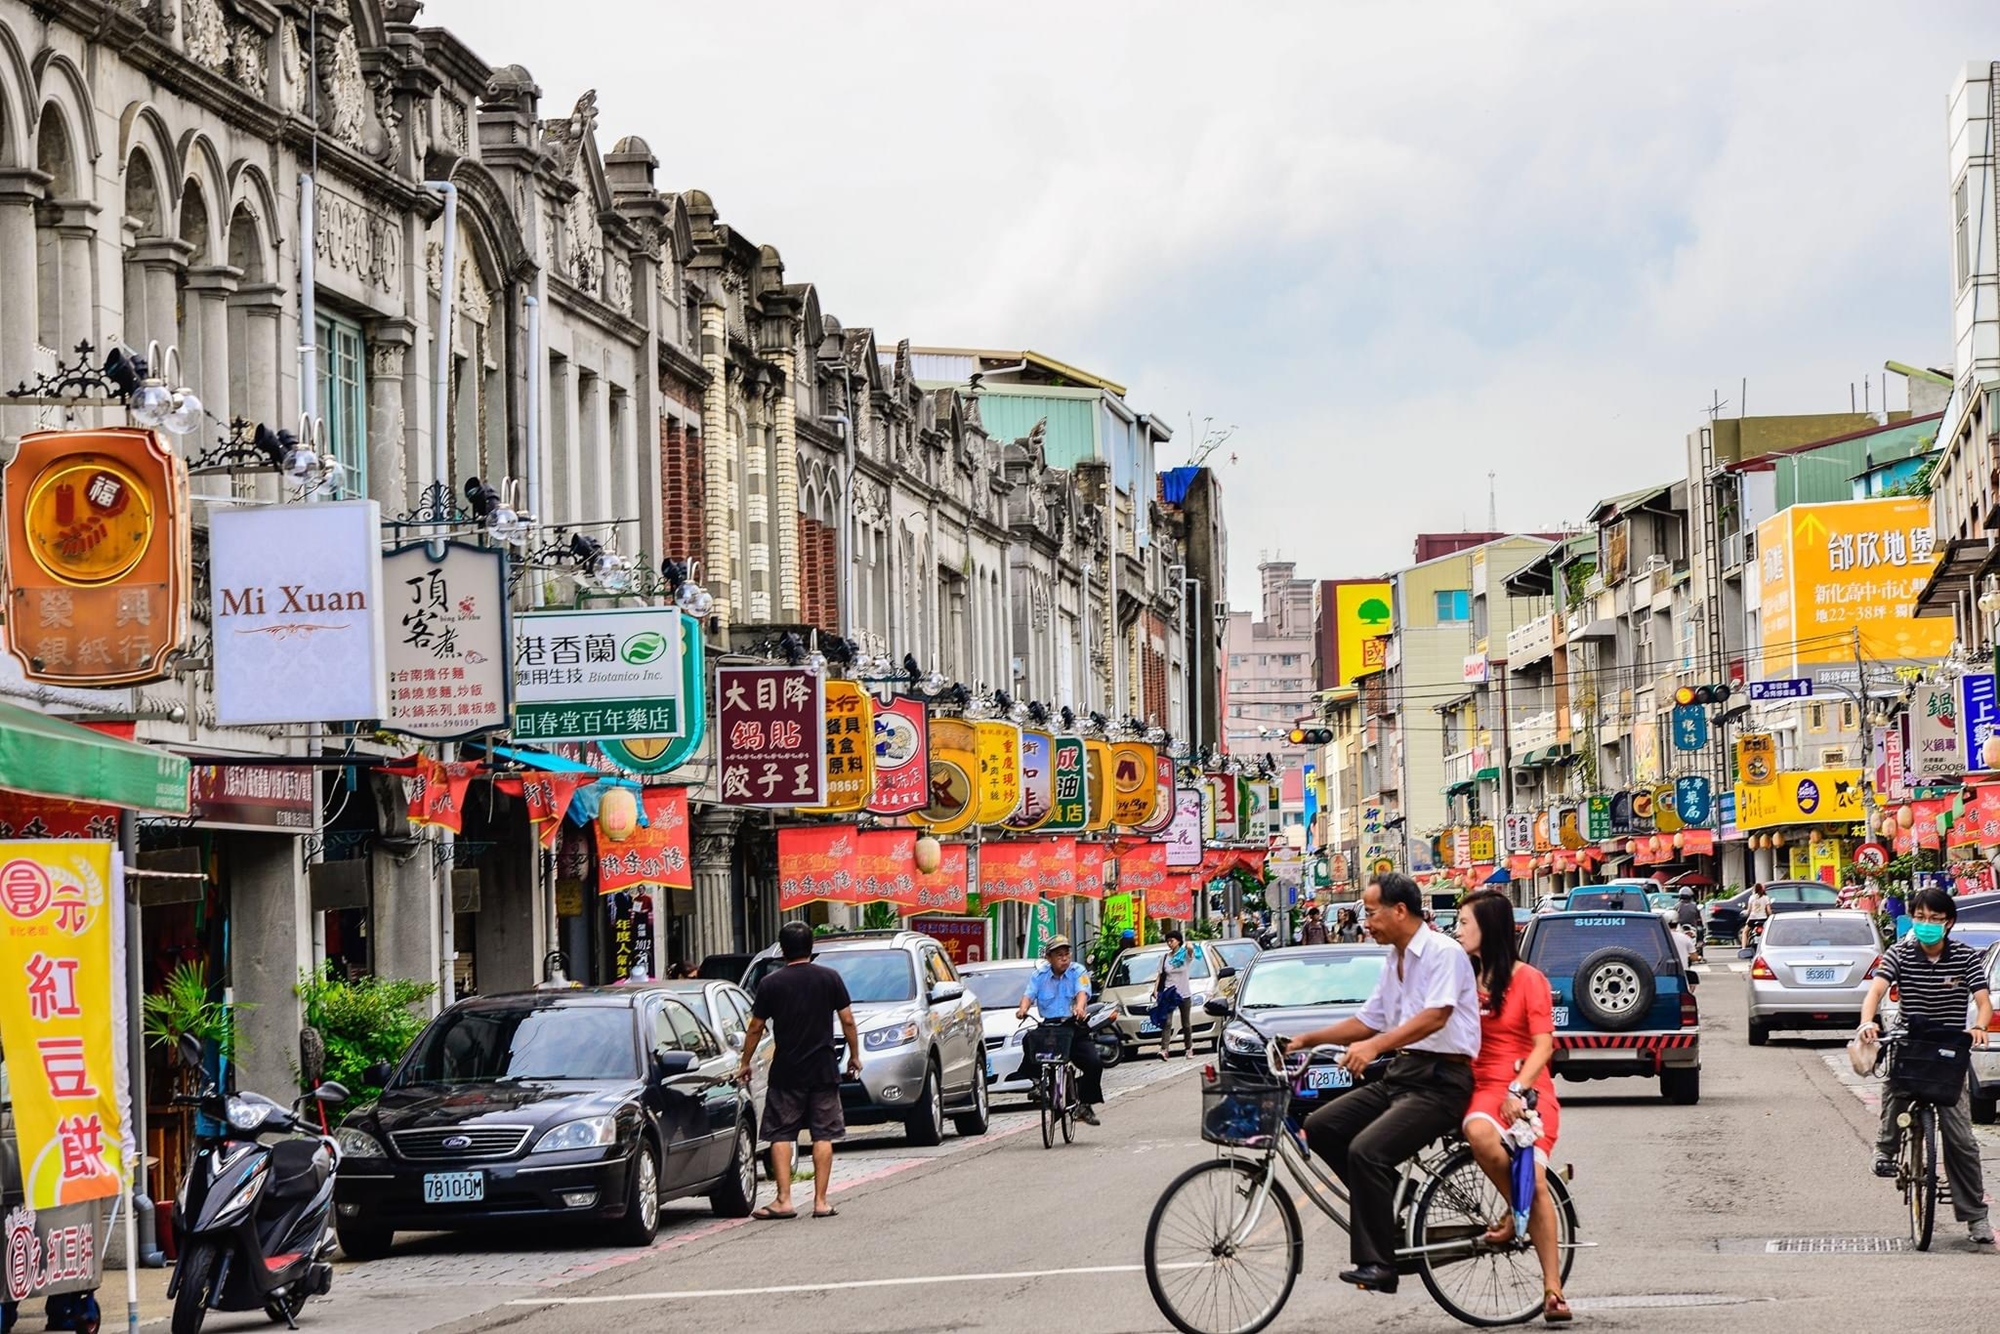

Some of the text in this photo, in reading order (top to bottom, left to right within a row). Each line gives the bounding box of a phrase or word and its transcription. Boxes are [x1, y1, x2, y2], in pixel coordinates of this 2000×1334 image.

[88, 475, 121, 508] 福
[219, 585, 368, 617] Mi Xuan
[515, 633, 616, 666] 港香蘭
[588, 671, 640, 683] Biotanico
[642, 669, 663, 681] Inc.
[722, 675, 812, 713] 大目降
[515, 707, 670, 736] 回春堂百年藥店
[730, 719, 802, 751] 鍋貼
[722, 762, 815, 799] 餃子王
[1574, 917, 1626, 927] SUZUKI
[25, 952, 111, 1182] 紅豆餅
